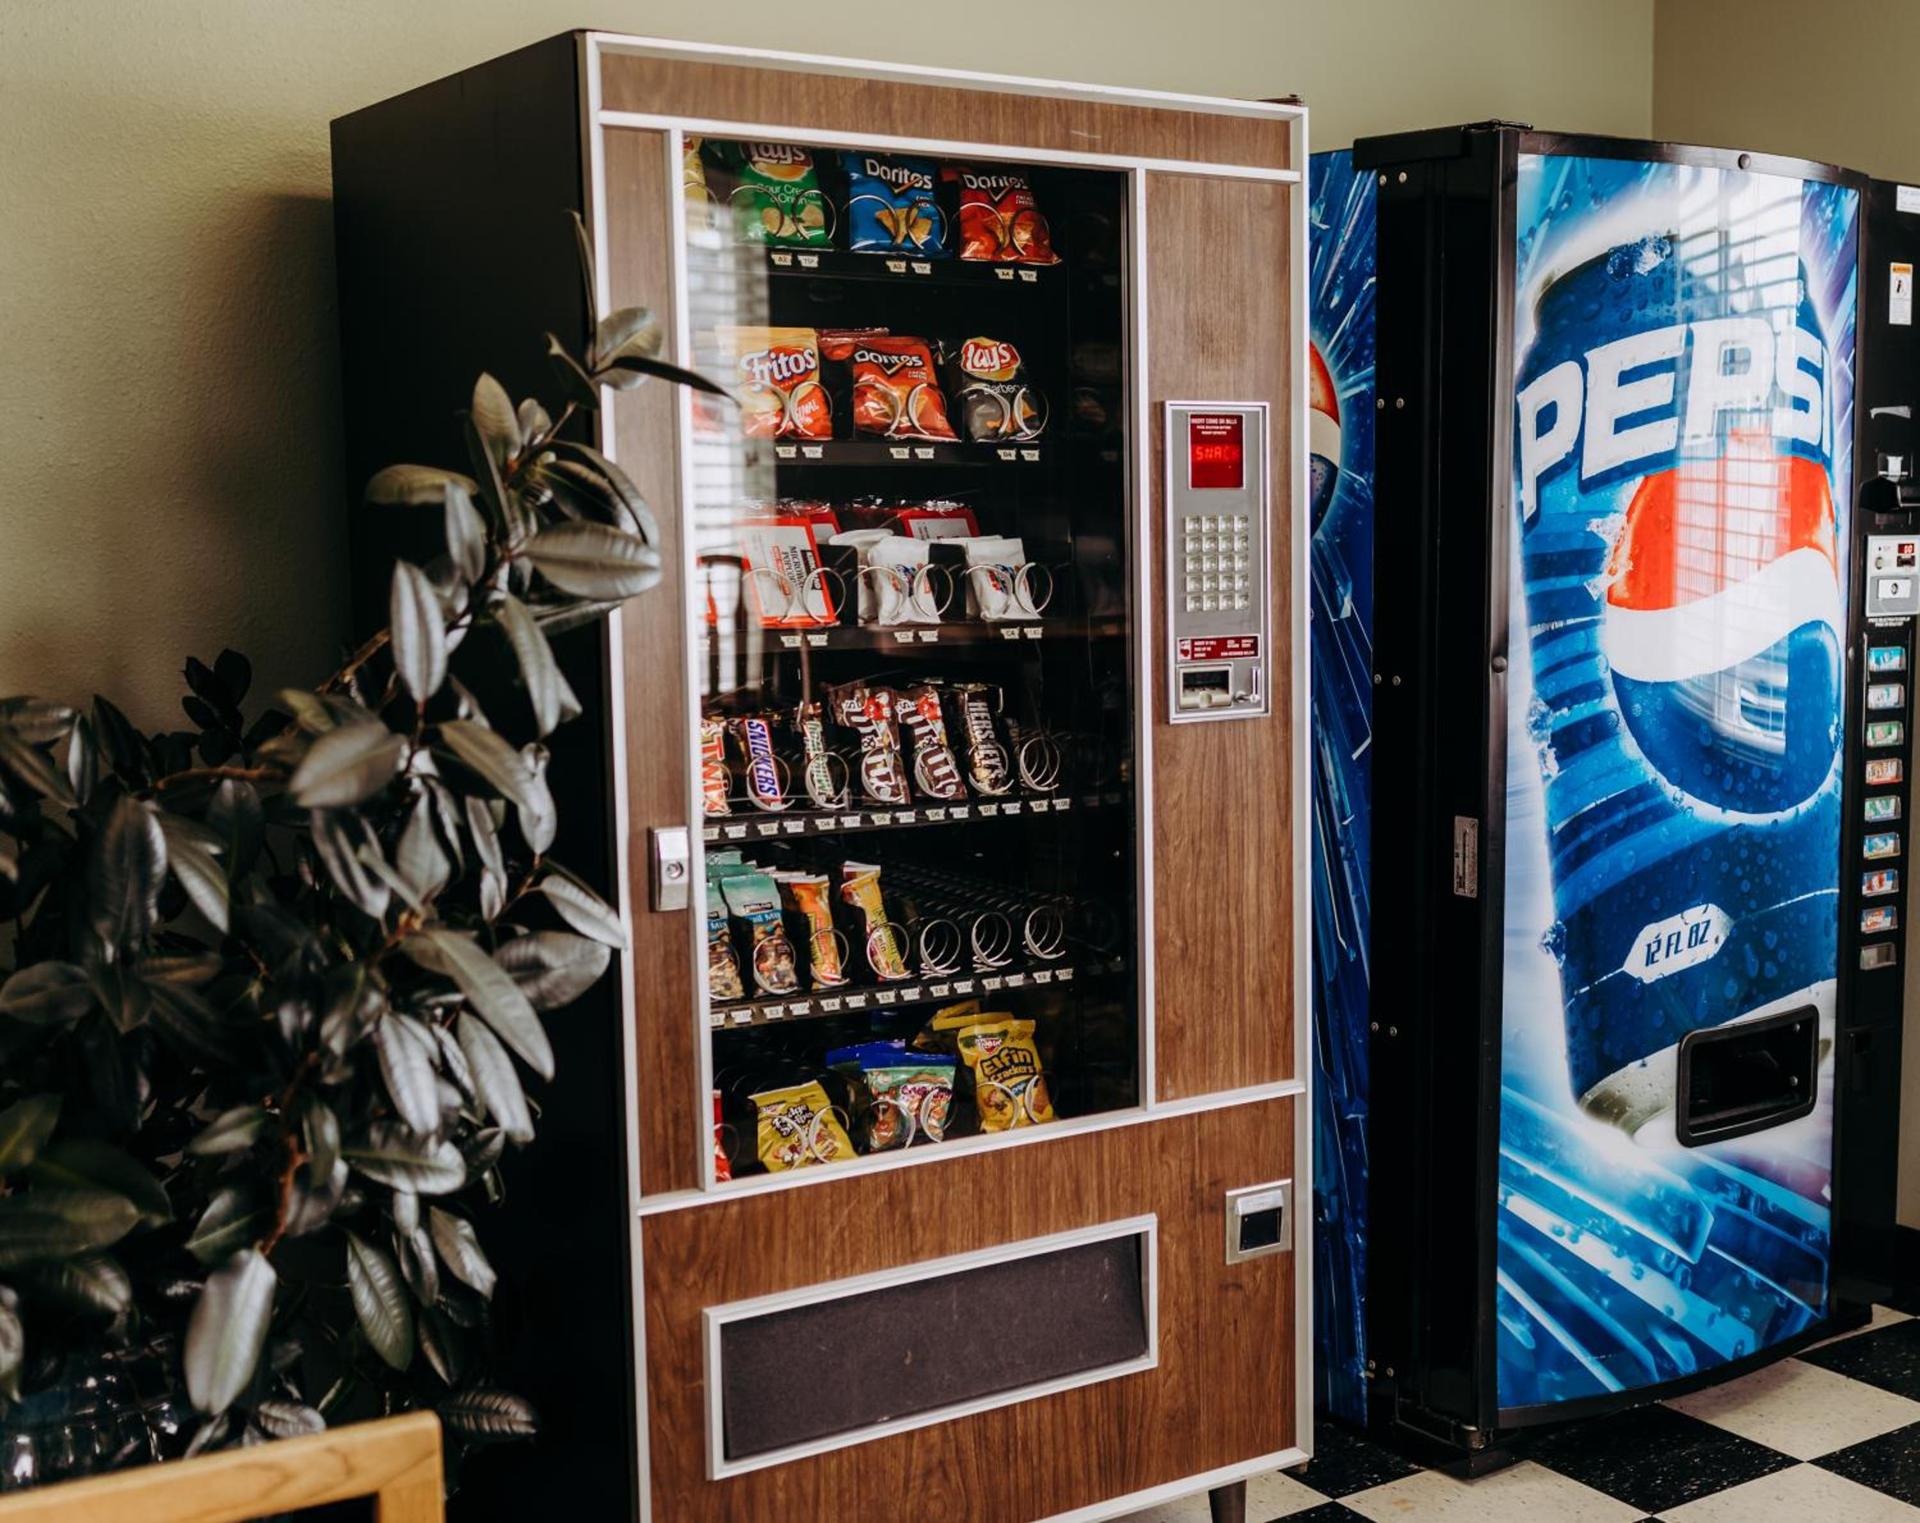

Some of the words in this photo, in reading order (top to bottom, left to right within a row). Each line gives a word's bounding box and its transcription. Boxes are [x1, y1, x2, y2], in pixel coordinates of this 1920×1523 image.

[865, 158, 933, 190] Doritos
[962, 173, 1029, 190] Doritos
[740, 348, 818, 394] Fritos
[853, 350, 924, 367] Doritos
[966, 343, 1012, 372] Lay's
[1516, 316, 1832, 523] PEPSI
[747, 719, 778, 797] SNICKERS
[1645, 938, 1662, 967] 12
[1665, 931, 1684, 959] FL
[1687, 919, 1711, 949] OZ
[981, 1048, 1034, 1076] Elfin
